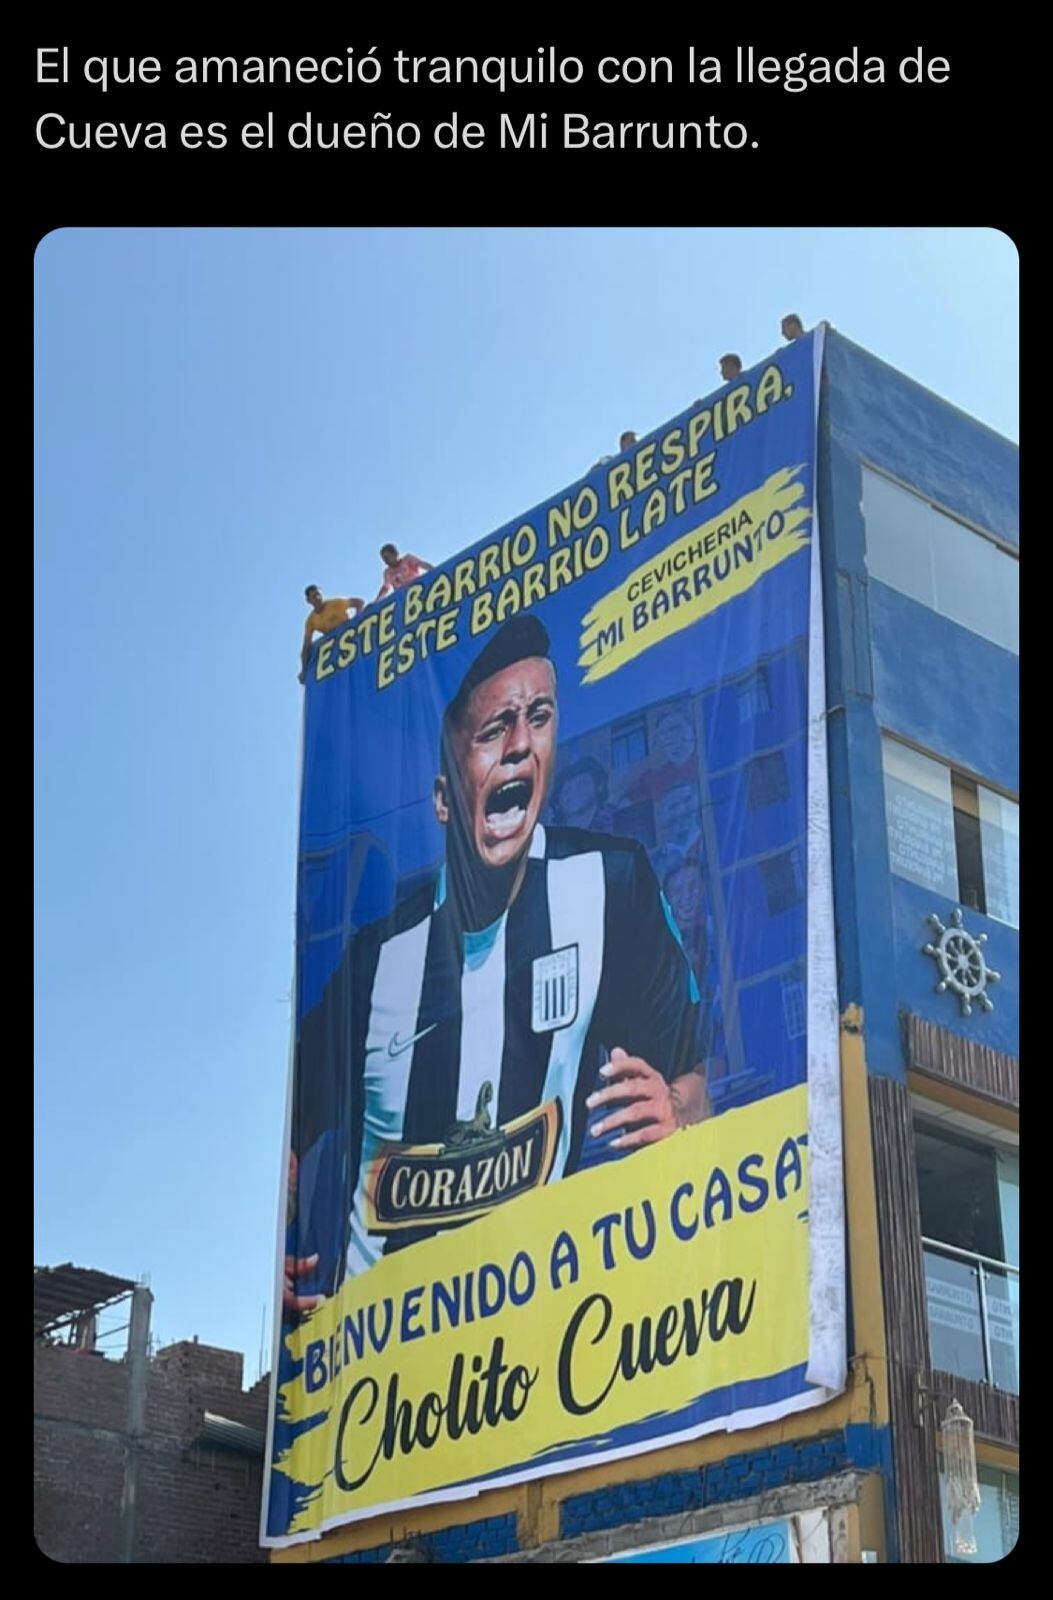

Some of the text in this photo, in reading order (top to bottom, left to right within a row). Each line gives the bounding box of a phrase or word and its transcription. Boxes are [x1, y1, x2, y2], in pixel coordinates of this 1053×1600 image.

[314, 363, 796, 681] ESTE BARRIO NO RESPIRA,
[375, 451, 720, 690] ESTE BARRIO LATE
[595, 509, 785, 657] MI BARRUNTO
[626, 509, 753, 602] CEVICHERIA
[549, 1231, 580, 1290] A
[592, 1200, 657, 1270] TU
[670, 1137, 802, 1241] CASA
[333, 1277, 758, 1492] Cholito Cueva
